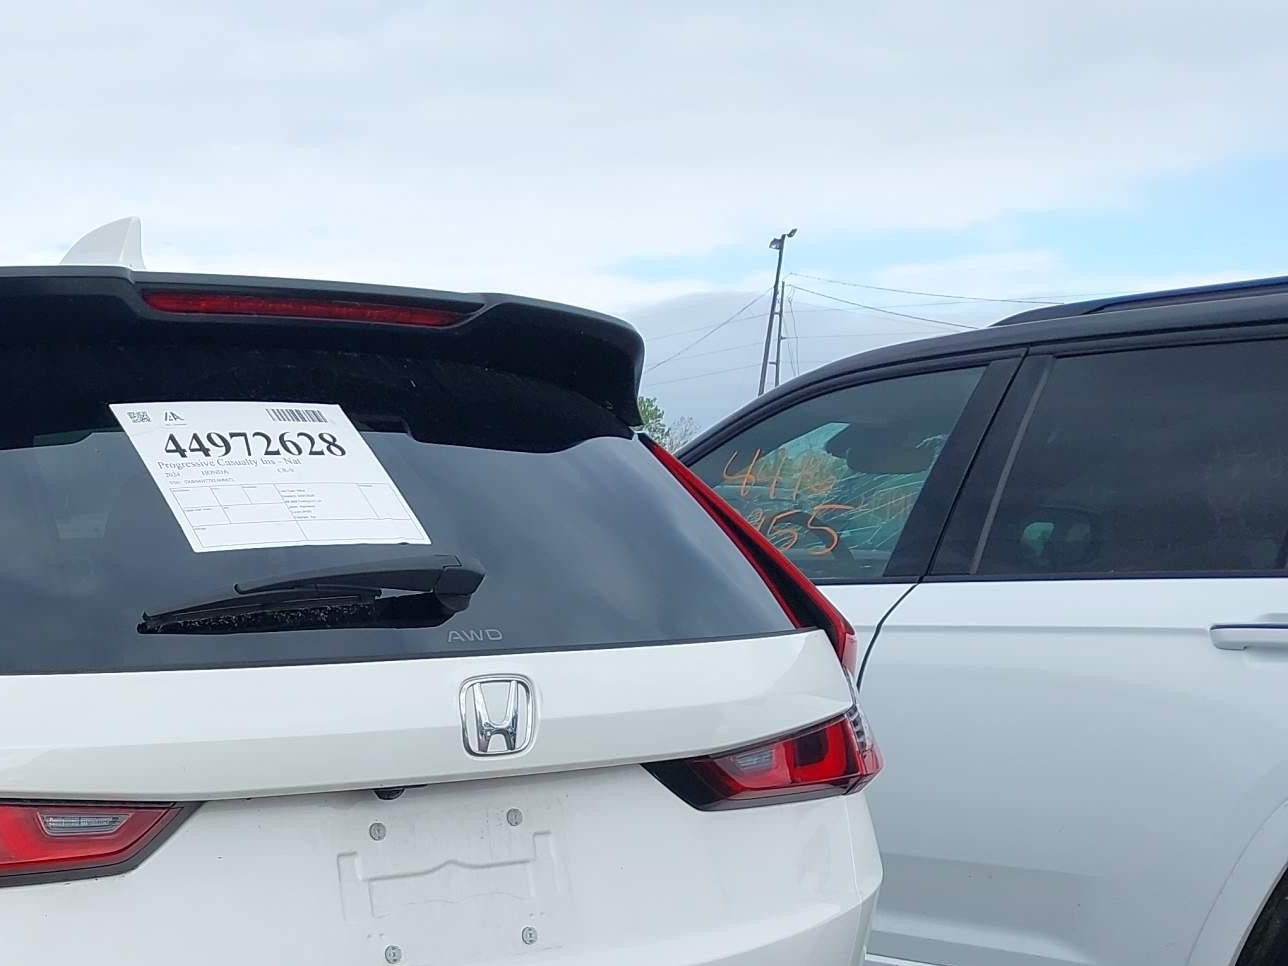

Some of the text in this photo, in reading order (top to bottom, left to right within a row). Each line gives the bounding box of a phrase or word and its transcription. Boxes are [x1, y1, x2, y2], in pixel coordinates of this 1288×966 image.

[164, 431, 347, 458] 44972628
[157, 459, 215, 470] Progressive
[216, 457, 259, 467] Casualty
[448, 628, 503, 643] AWD
